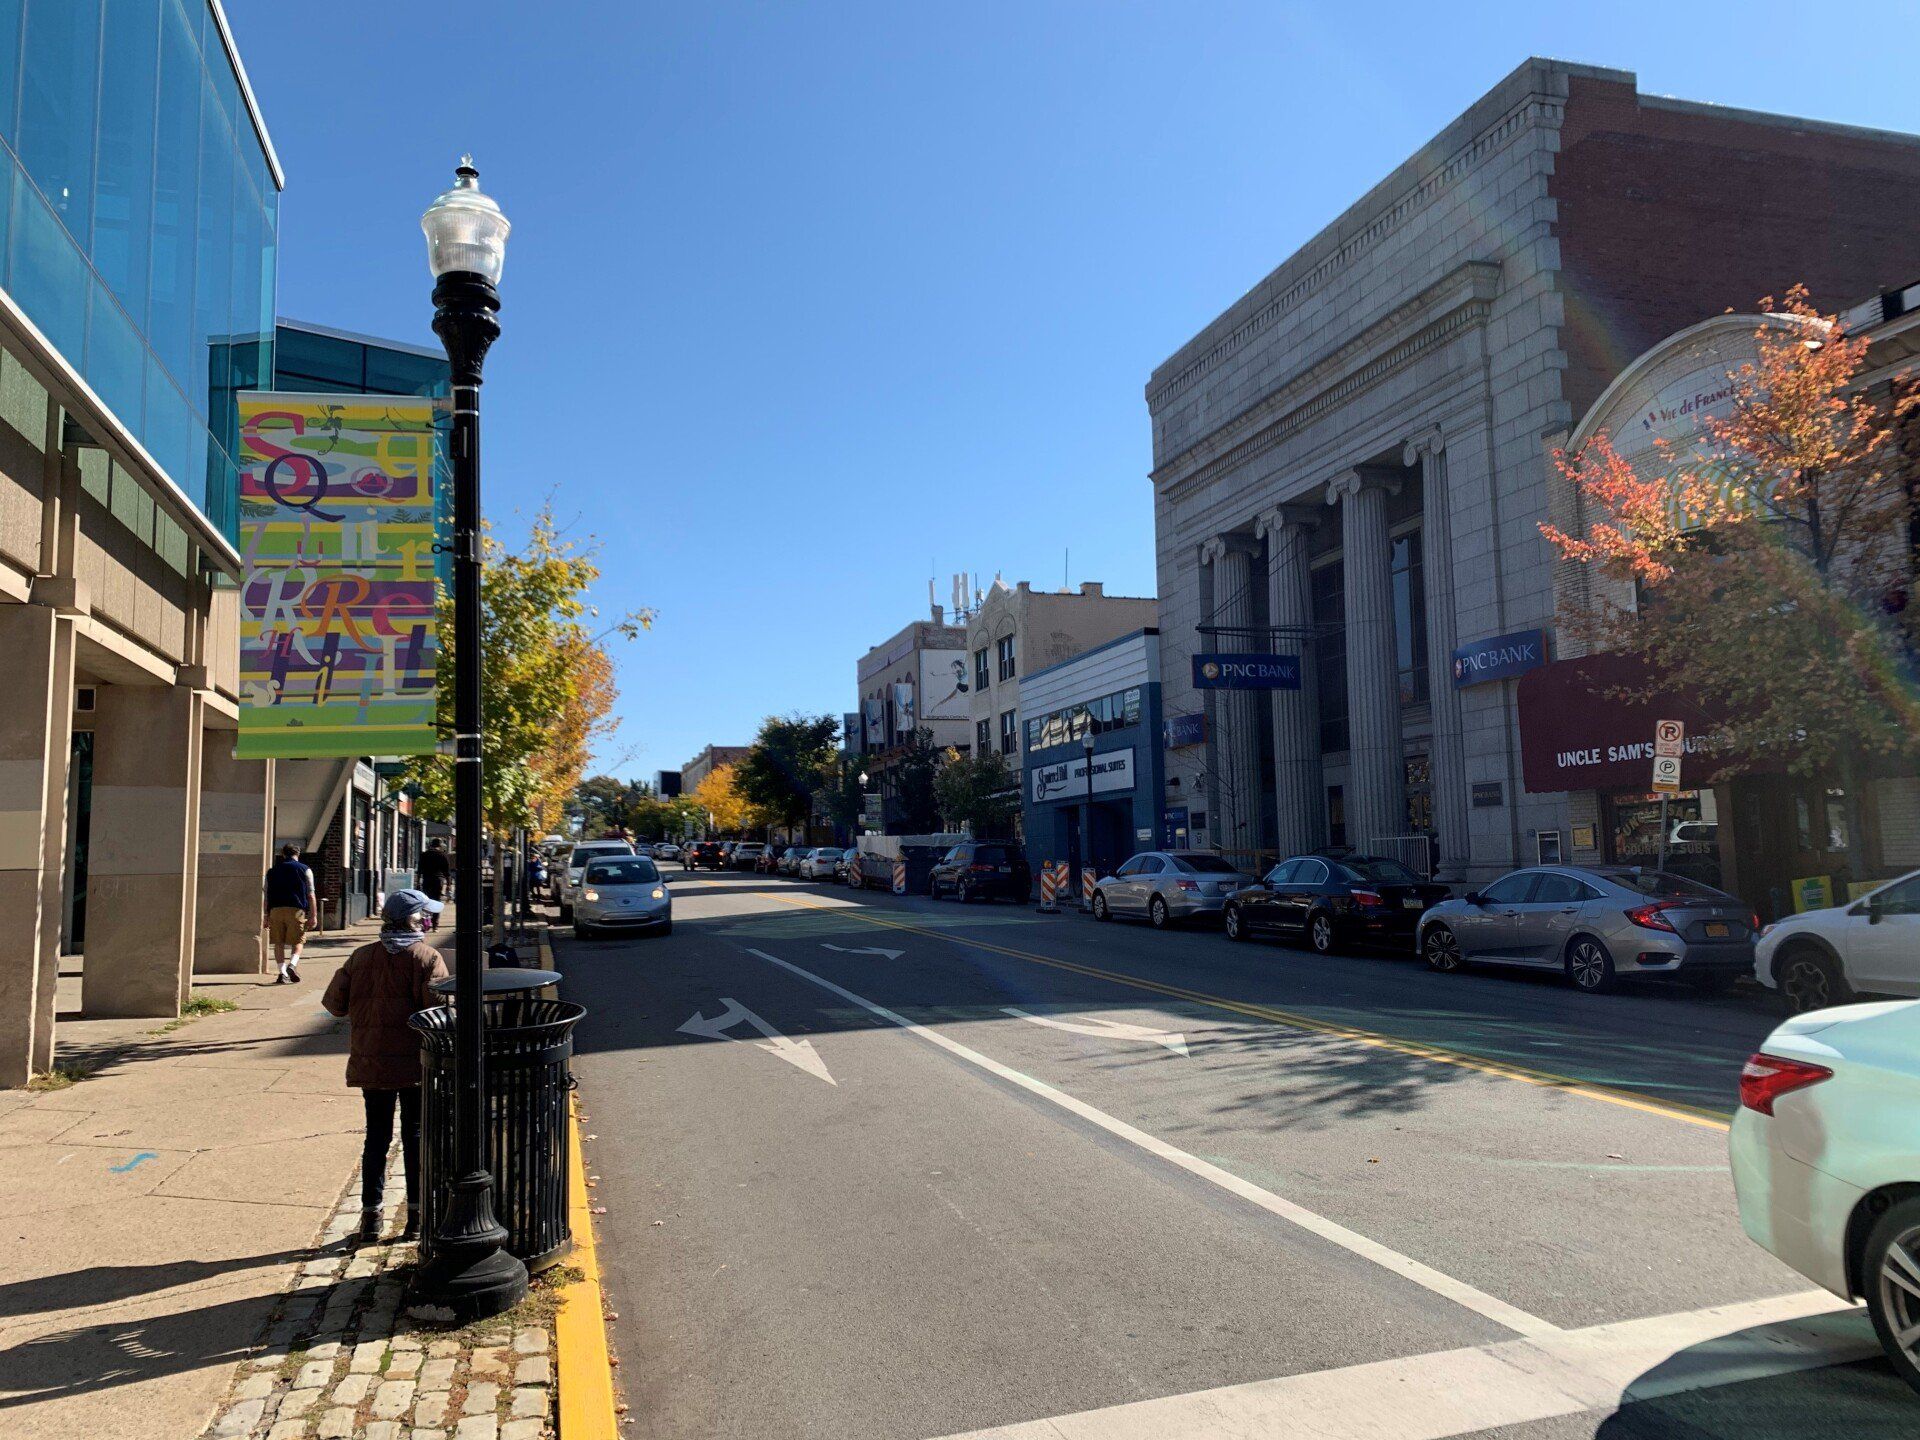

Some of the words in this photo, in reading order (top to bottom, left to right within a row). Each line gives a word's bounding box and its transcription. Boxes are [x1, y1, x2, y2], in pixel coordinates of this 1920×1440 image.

[1221, 663, 1256, 677] PNC
[1258, 664, 1296, 680] BANK
[1463, 652, 1487, 674] PNC
[1488, 643, 1536, 667] BANK
[1557, 748, 1602, 768] UNCLE
[1608, 742, 1655, 762] SAM'S
